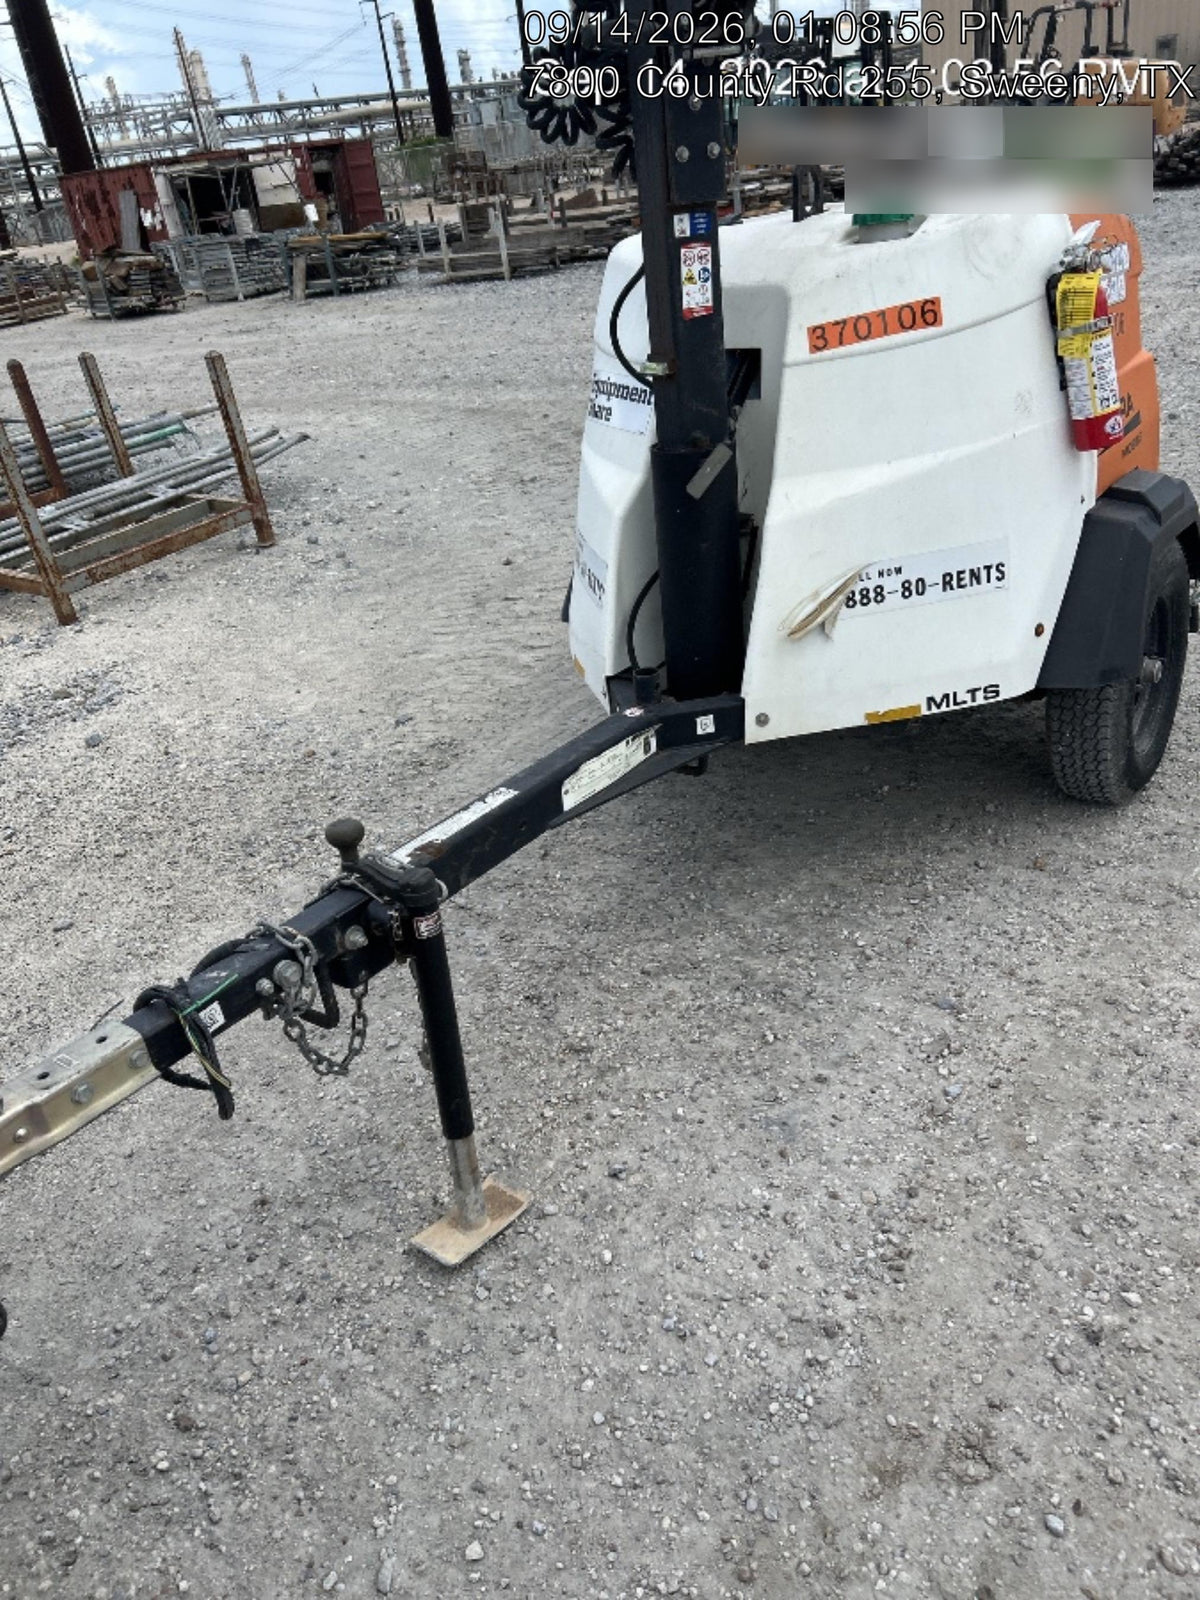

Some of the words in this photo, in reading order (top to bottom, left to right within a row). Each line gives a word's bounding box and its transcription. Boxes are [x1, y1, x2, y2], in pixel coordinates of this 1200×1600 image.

[811, 299, 939, 351] 370106
[877, 566, 903, 579] NOW
[925, 683, 1000, 712] MLTS
